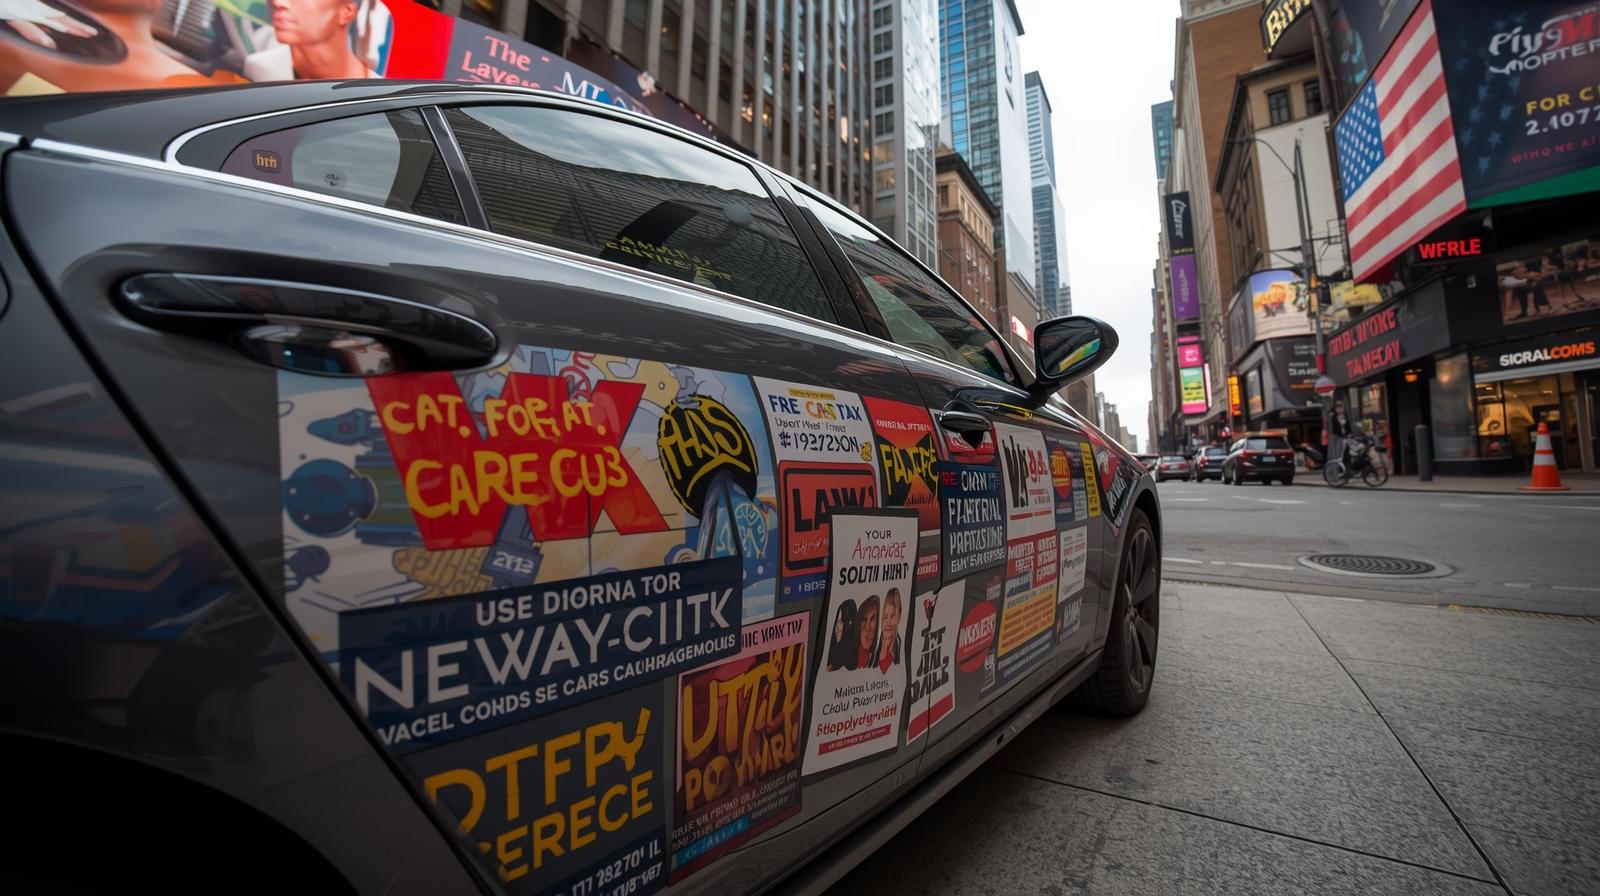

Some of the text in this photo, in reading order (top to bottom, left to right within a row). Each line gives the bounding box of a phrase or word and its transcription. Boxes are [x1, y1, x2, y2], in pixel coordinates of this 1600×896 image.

[484, 35, 531, 72] The
[1526, 86, 1600, 115] FOR C
[768, 394, 801, 414] FRE
[836, 403, 863, 422] TAX
[405, 449, 551, 518] CARE
[865, 529, 892, 540] YOUR
[476, 571, 681, 627] USE DIORNA TOR
[377, 711, 455, 746] VACEL
[535, 683, 558, 704] SE
[562, 669, 610, 696] CARS
